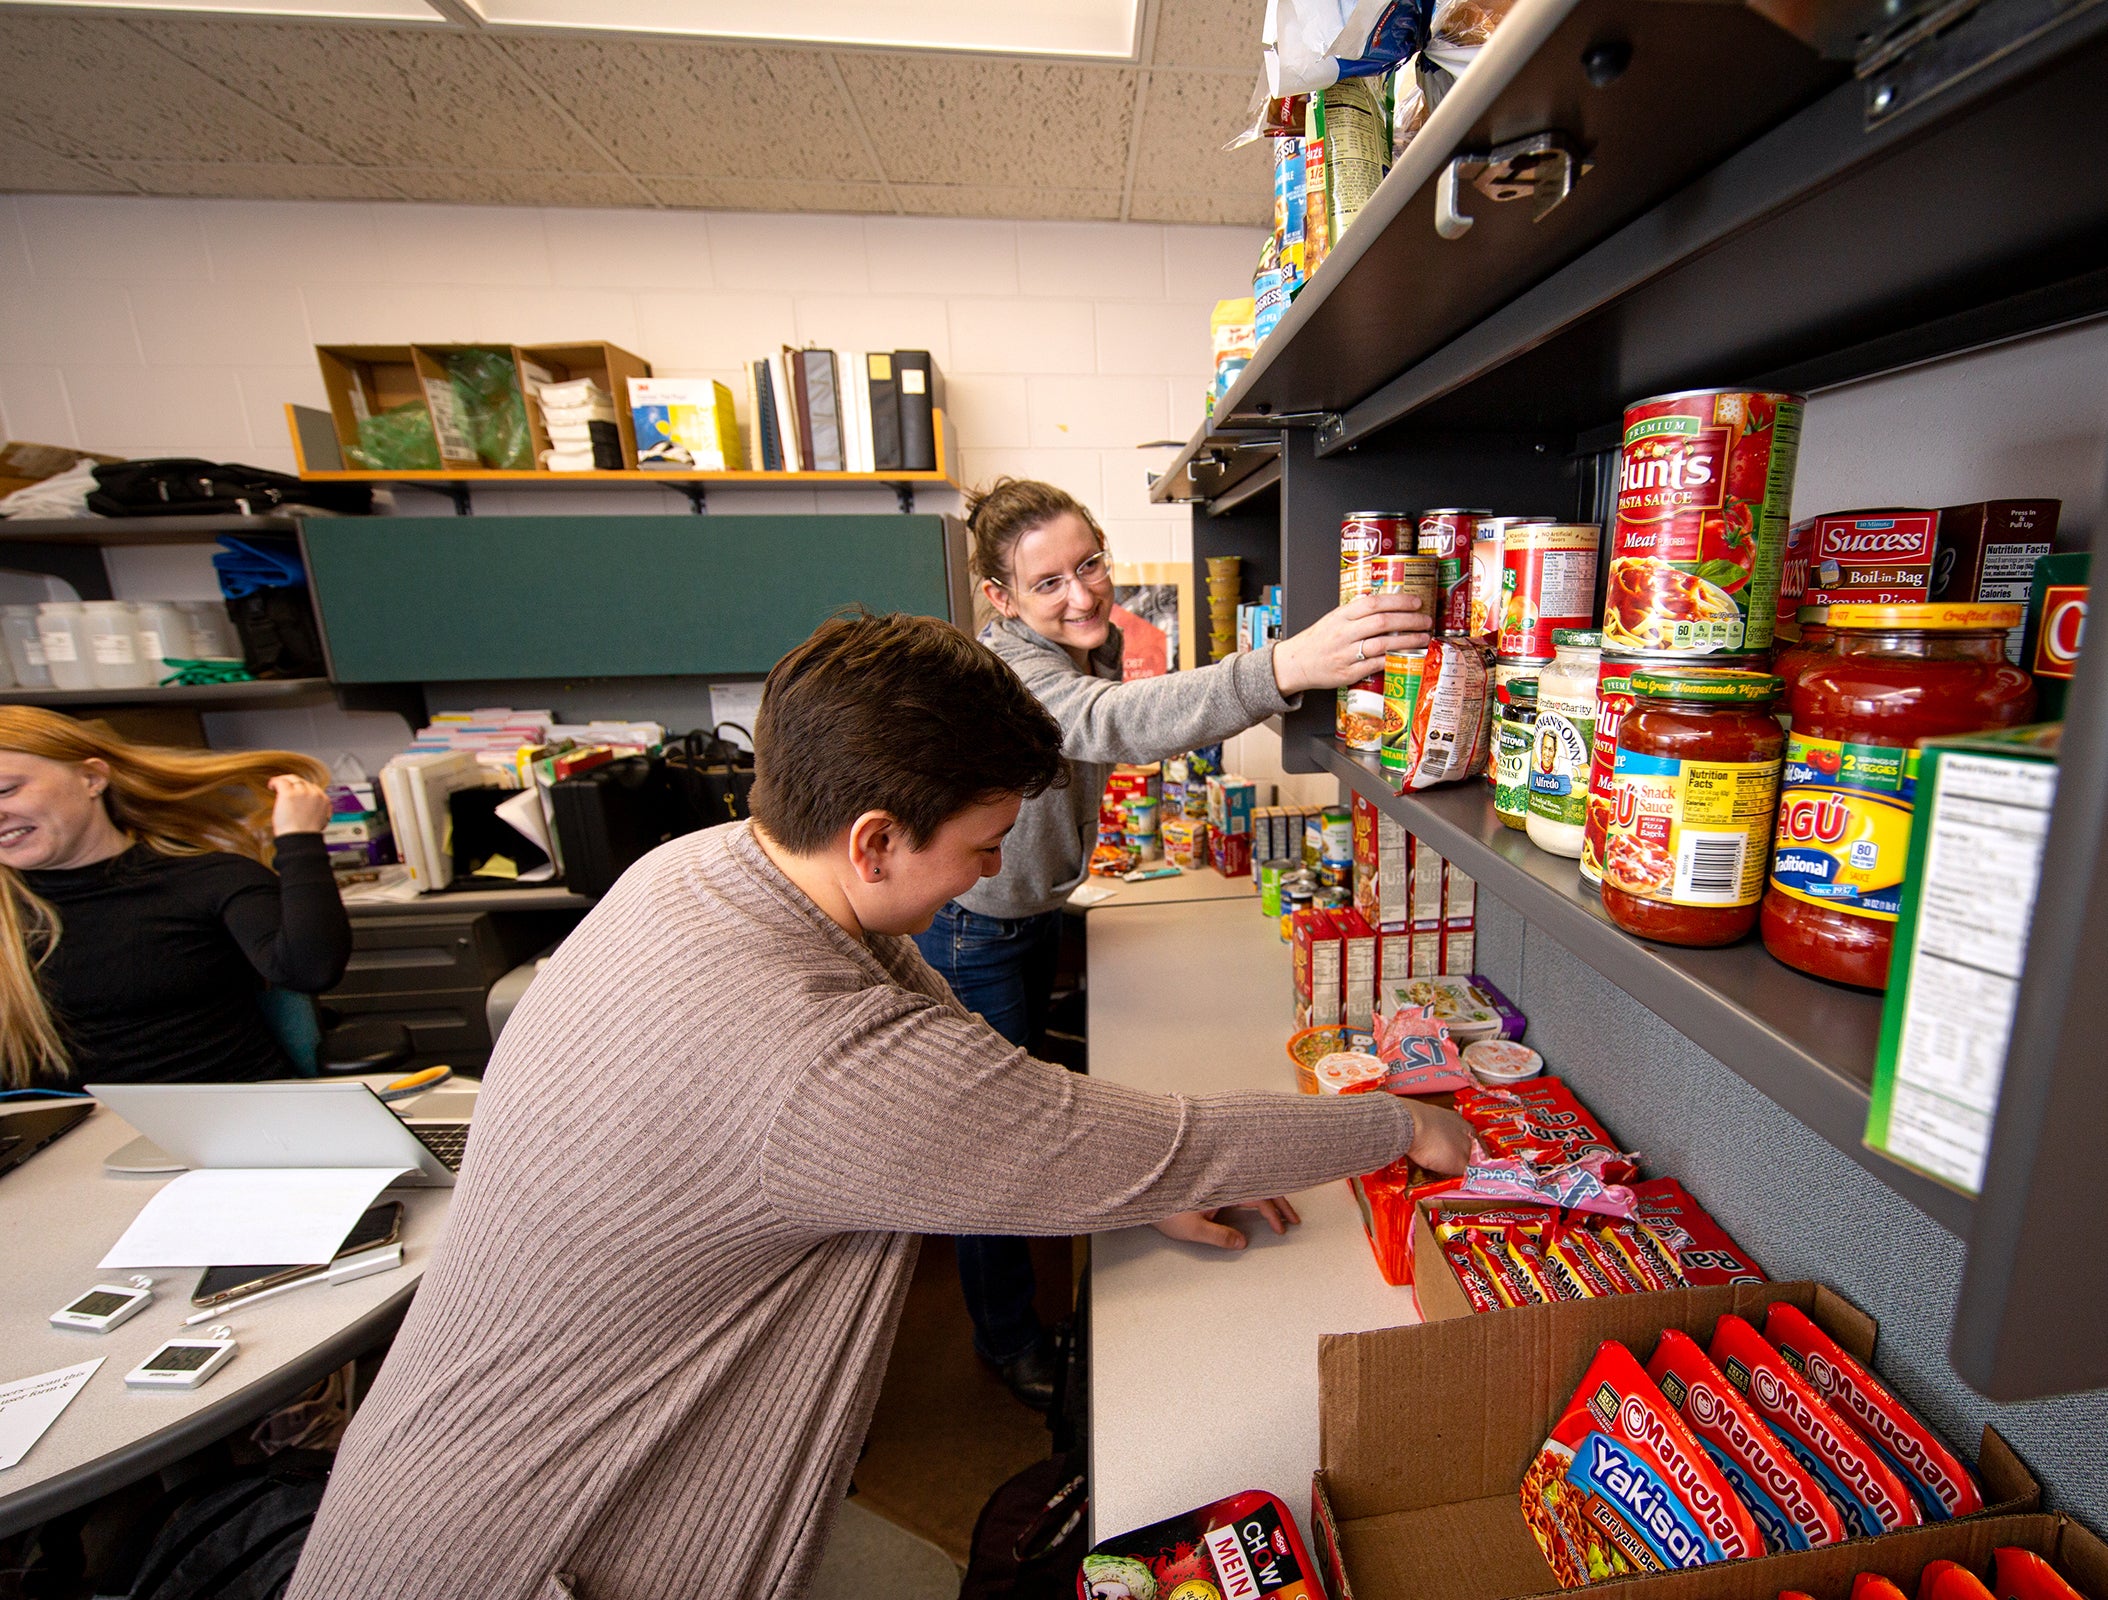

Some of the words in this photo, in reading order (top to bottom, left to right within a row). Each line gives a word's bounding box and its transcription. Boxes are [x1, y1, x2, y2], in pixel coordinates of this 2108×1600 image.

[1306, 148, 1323, 161] SIZE
[1310, 167, 1324, 180] 1/2
[1629, 421, 1686, 440] PREMIUM
[1619, 495, 1643, 511] PASTA
[1644, 491, 1693, 507] SAUCE
[1624, 532, 1657, 548] Meat
[1824, 528, 1923, 552] Success
[1987, 545, 2023, 554] Nutrition
[2025, 545, 2048, 554] Facts
[1850, 571, 1923, 586] Boil-in-Bag
[1980, 589, 2011, 598] Calories
[1943, 610, 1990, 624] Crafted
[1678, 625, 1689, 635] 60
[1648, 680, 1673, 693] Great
[1673, 684, 1736, 695] Homemade
[1738, 683, 1772, 698] Pizzas!
[1561, 702, 1592, 715] Charity
[1593, 738, 1614, 755] PASTA
[1843, 755, 1855, 770] 2
[1857, 756, 1889, 766] SERVINGS
[1857, 764, 1898, 775] VEGGIES
[1690, 769, 1728, 780] Nutrition
[1535, 777, 1559, 790] Alfredo
[1689, 778, 1713, 788] Facts
[1641, 785, 1676, 800] Snack
[1639, 799, 1673, 814] Sauce
[1640, 829, 1665, 839] Bagels
[1642, 822, 1663, 831] Pizza
[1857, 845, 1871, 856] 80
[1852, 855, 1874, 863] CALORIES
[1850, 873, 1870, 883] SAUCE
[1809, 884, 1831, 894] Since
[1833, 885, 1851, 895] 1937
[1596, 1251, 1611, 1268] Beef
[1634, 1254, 1648, 1270] Beef
[1501, 1272, 1515, 1288] Beef
[1537, 1271, 1551, 1288] Beef
[1577, 1265, 1590, 1281] Beef
[1830, 1366, 1958, 1503] Maruchan
[1777, 1381, 1900, 1527] Maruchan
[1714, 1399, 1827, 1545] Maruchan
[1643, 1411, 1746, 1558] Maruchan
[1592, 1502, 1643, 1559] Teriyaki
[1273, 1529, 1287, 1553] NISSIN
[1242, 1521, 1283, 1586] CHOW
[1215, 1536, 1252, 1598] MEIN
